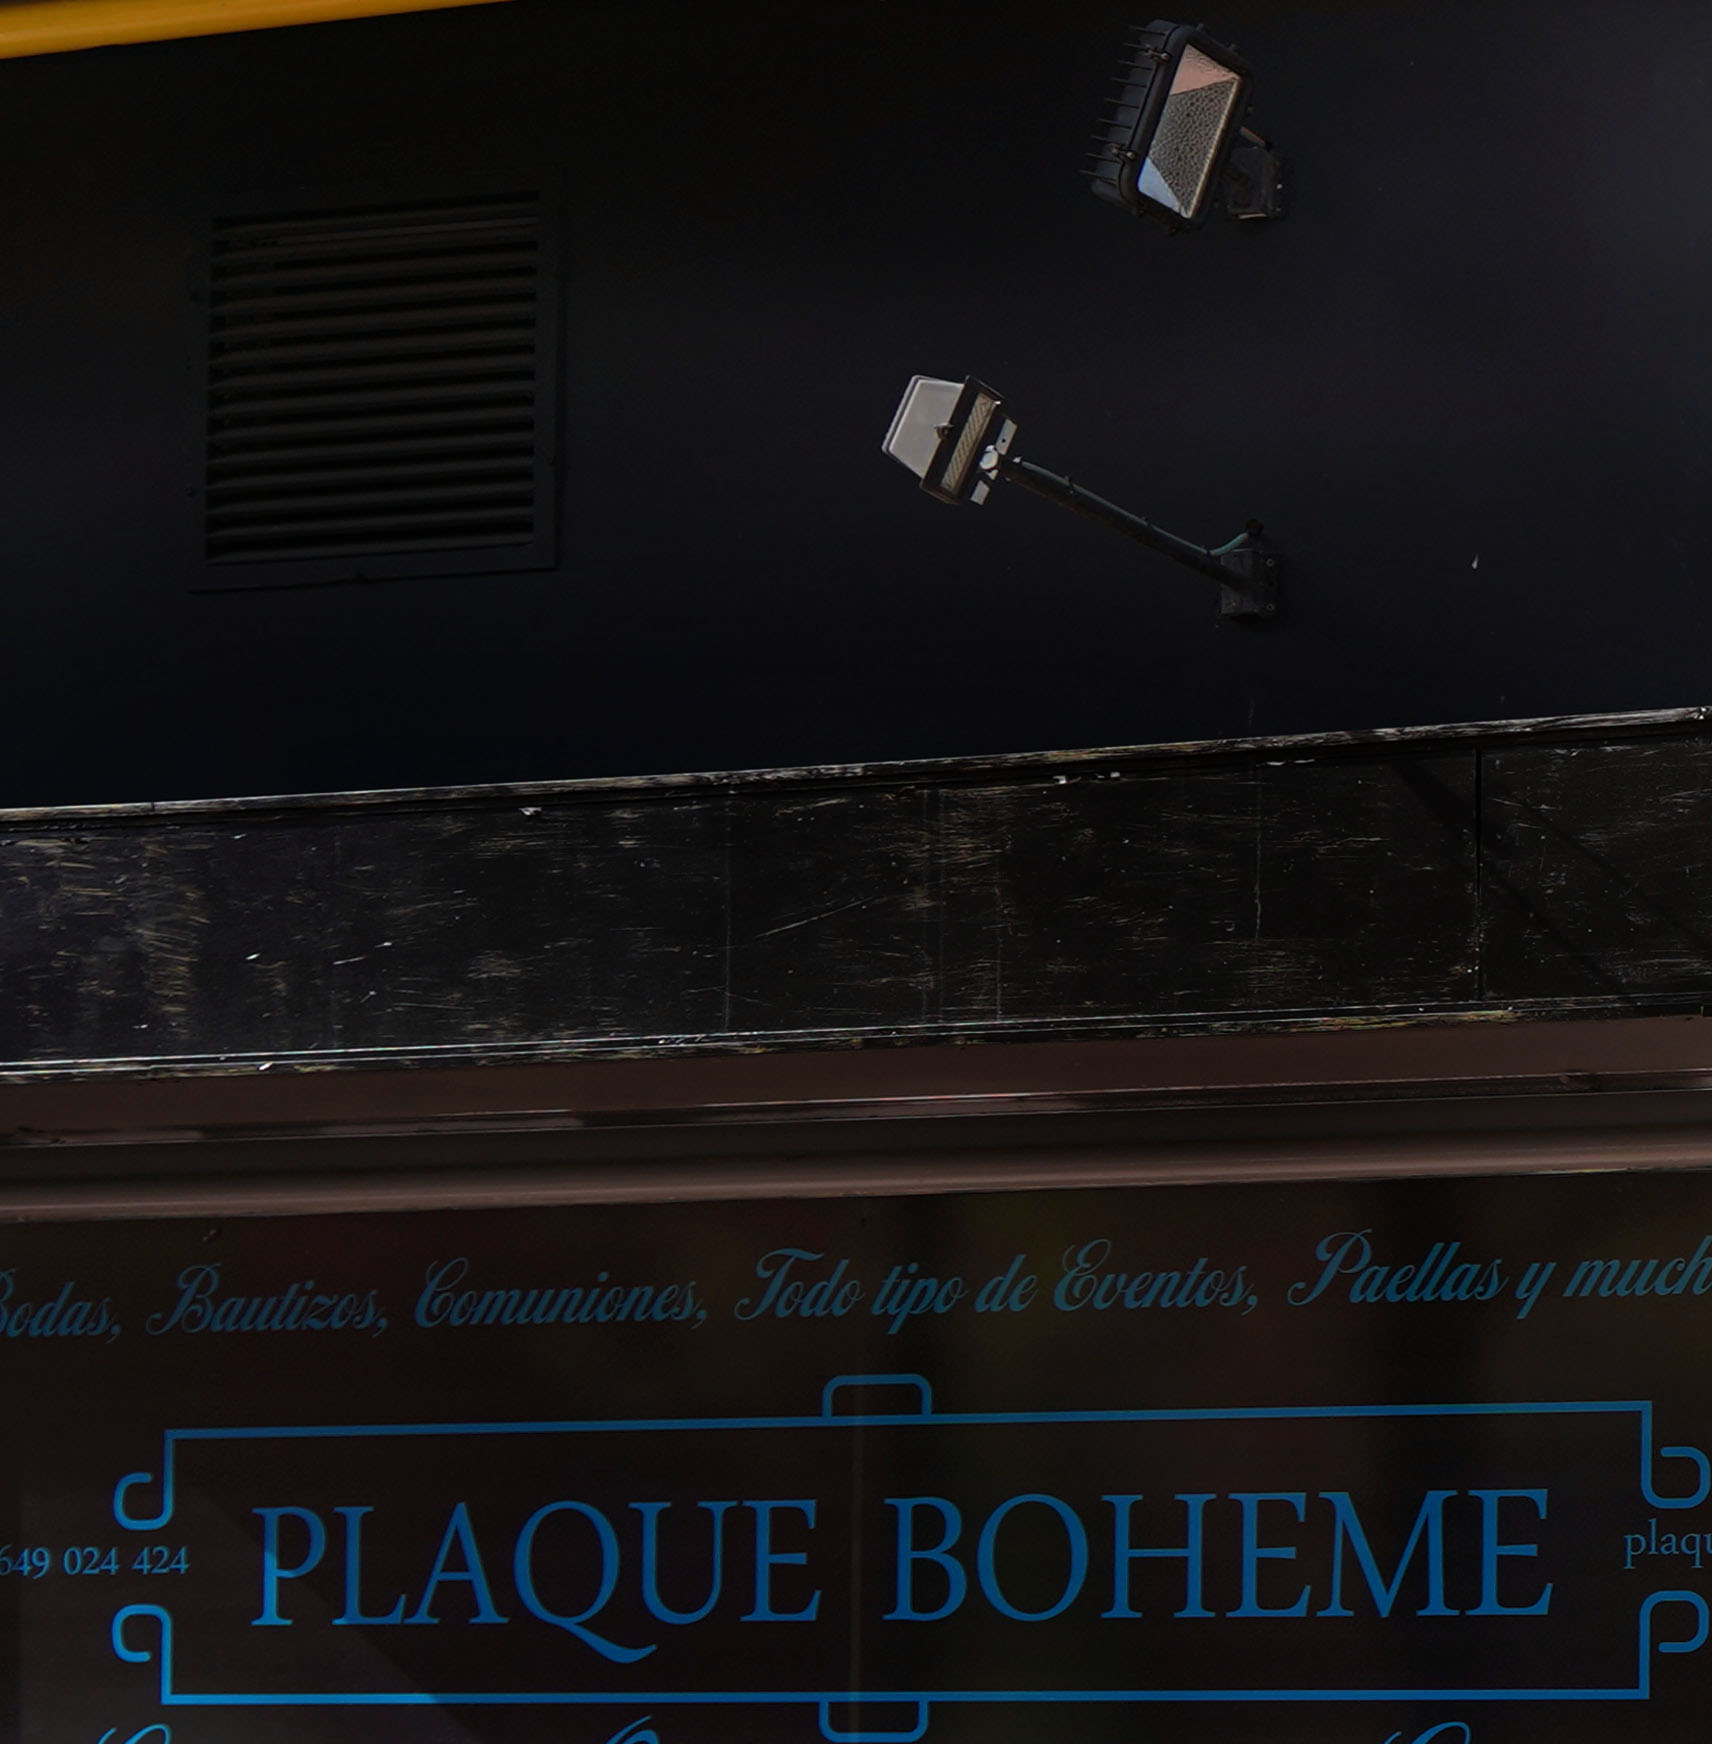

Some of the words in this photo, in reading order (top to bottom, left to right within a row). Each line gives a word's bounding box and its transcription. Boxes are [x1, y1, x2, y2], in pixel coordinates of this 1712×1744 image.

[0, 1269, 121, 1344] odas,
[146, 1262, 389, 1338] Bautizos,
[413, 1257, 709, 1330] Comuniones,
[734, 1247, 866, 1323] Todo
[870, 1261, 967, 1335] tipo
[973, 1254, 1038, 1314] de
[1052, 1238, 1260, 1316] Eventos,
[1287, 1227, 1509, 1308] Paellas
[1513, 1261, 1556, 1320] y
[62, 1546, 120, 1576] 024
[131, 1545, 190, 1576] 424
[250, 1499, 820, 1664] PLAQUE
[882, 1488, 1554, 1622] BOHEME
